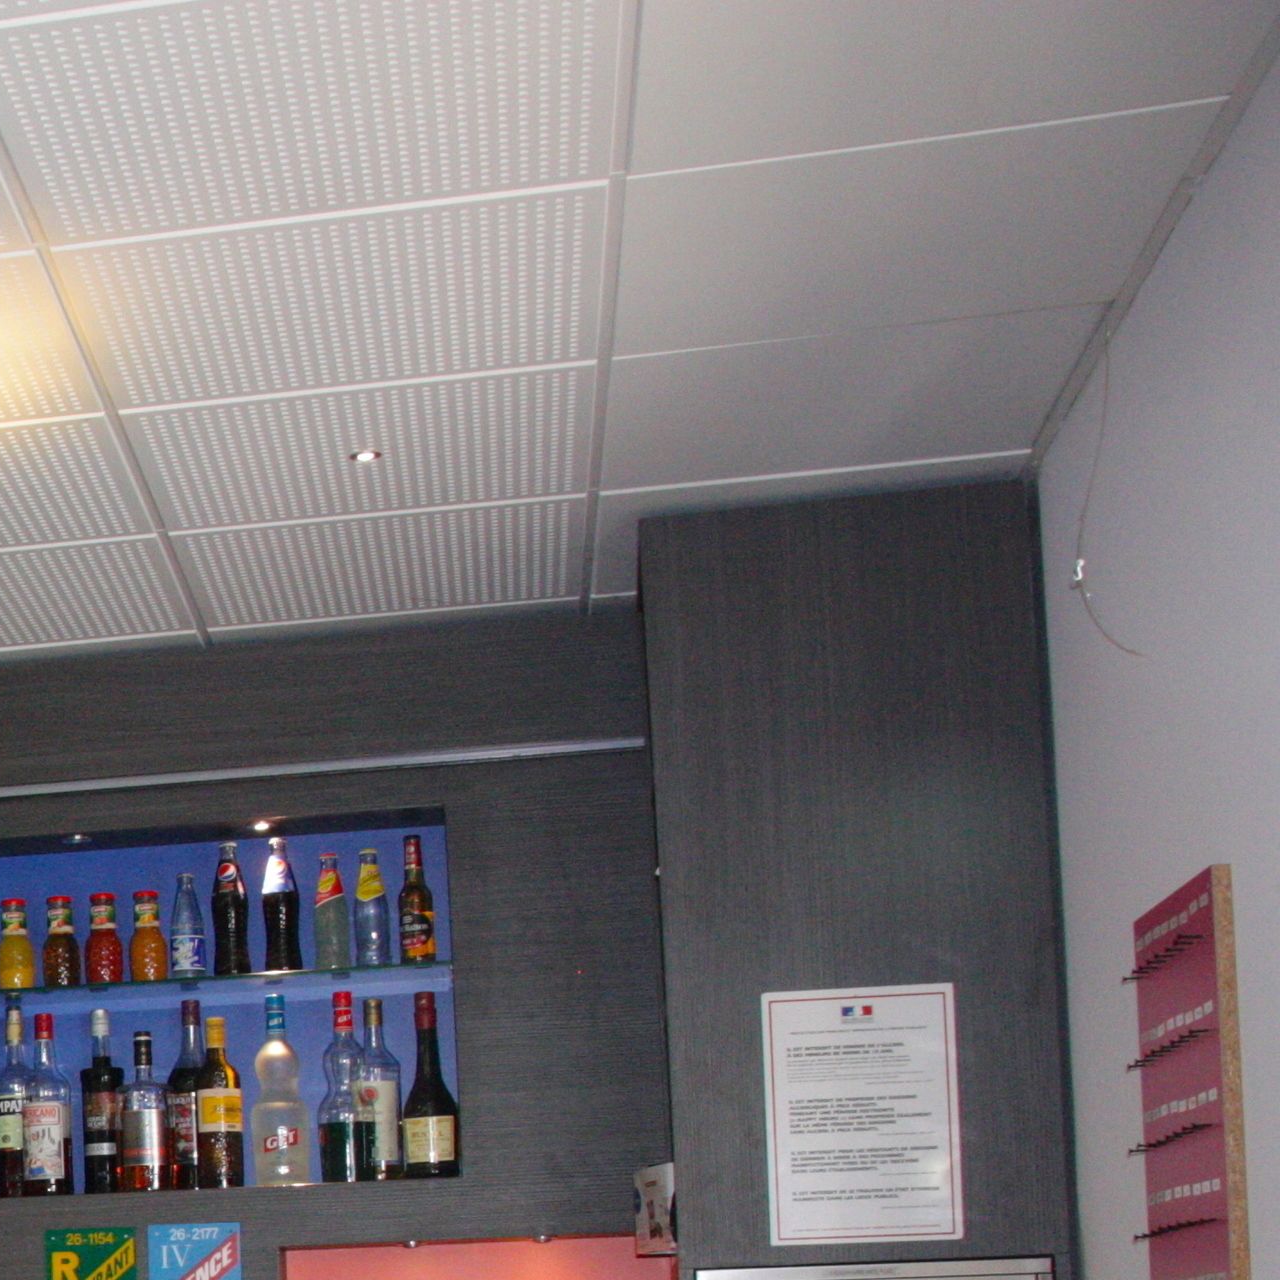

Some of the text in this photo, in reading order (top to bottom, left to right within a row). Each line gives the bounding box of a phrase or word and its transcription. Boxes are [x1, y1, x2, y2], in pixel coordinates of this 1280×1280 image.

[65, 1232, 115, 1246] 26-1154
[170, 1227, 219, 1241] 26-2177
[160, 1243, 193, 1269] IV
